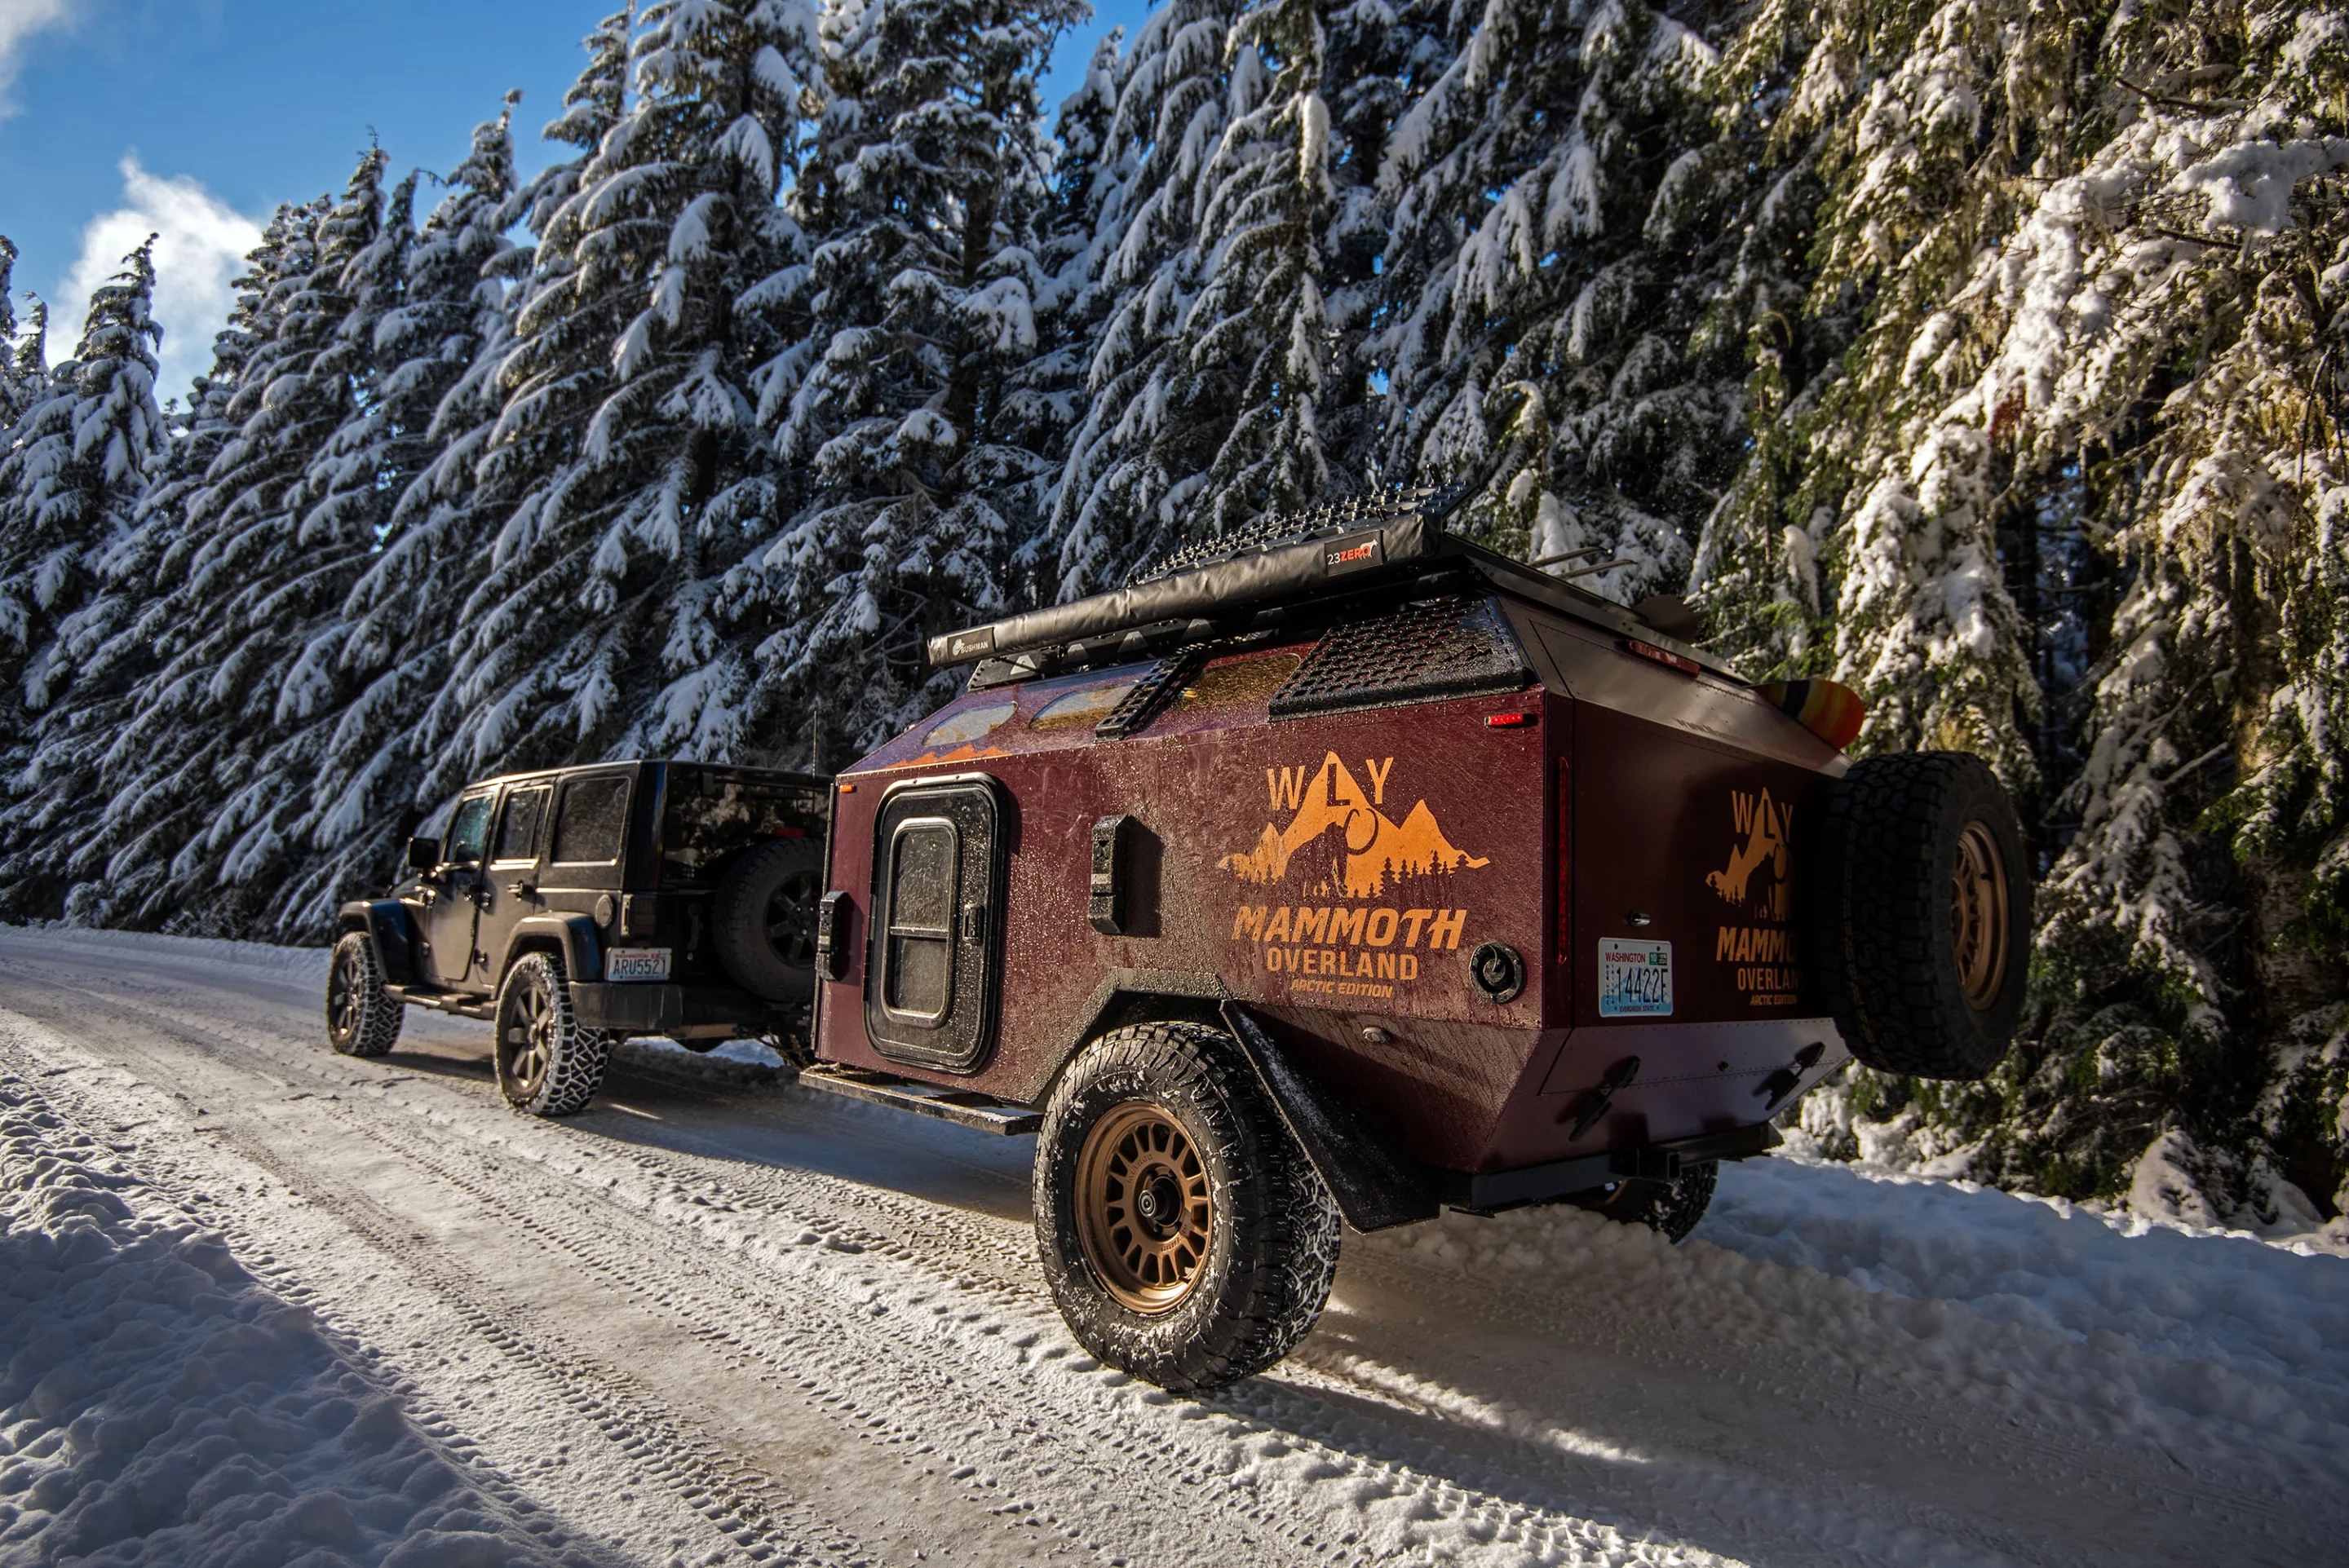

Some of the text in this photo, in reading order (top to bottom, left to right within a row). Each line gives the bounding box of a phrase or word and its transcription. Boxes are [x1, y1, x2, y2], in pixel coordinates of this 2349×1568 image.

[1328, 546, 1370, 564] 23ZERO
[961, 641, 988, 653] BUSHMAN
[1234, 907, 1466, 949] MAMMOTH
[1267, 947, 1418, 981] OVERLAND
[1605, 952, 1645, 962] WASHINGTON
[614, 960, 666, 974] ARU5521
[1290, 978, 1393, 998] ARCTIC EDITION
[1617, 967, 1668, 1002] 14422F
[1750, 994, 1772, 1006] ARCTIC
